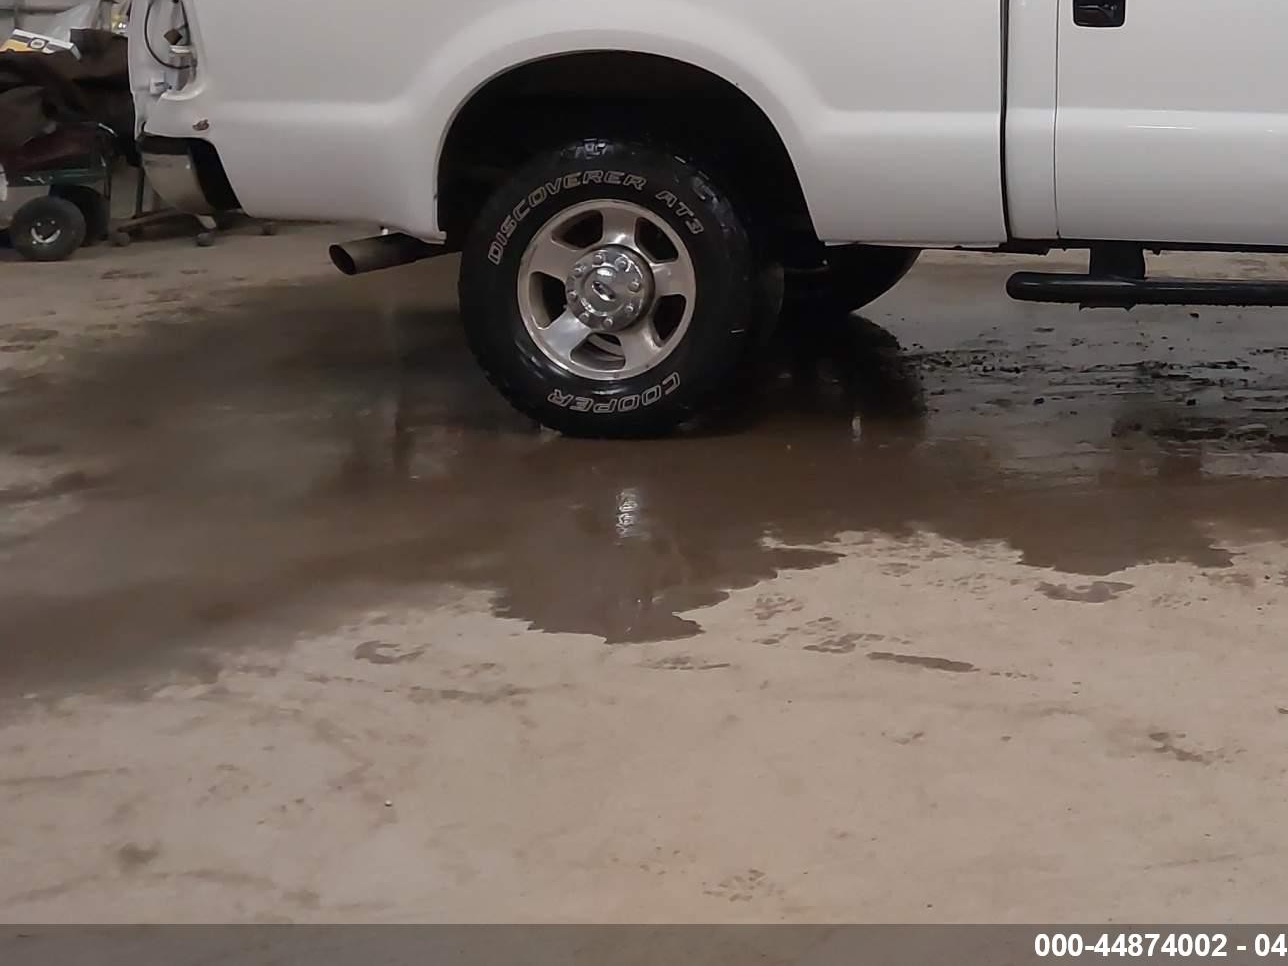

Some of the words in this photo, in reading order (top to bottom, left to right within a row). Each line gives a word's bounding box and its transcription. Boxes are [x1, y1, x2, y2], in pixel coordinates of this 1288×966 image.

[487, 170, 647, 265] DISCOVERER
[655, 190, 704, 235] AT3
[547, 371, 681, 413] COOPER
